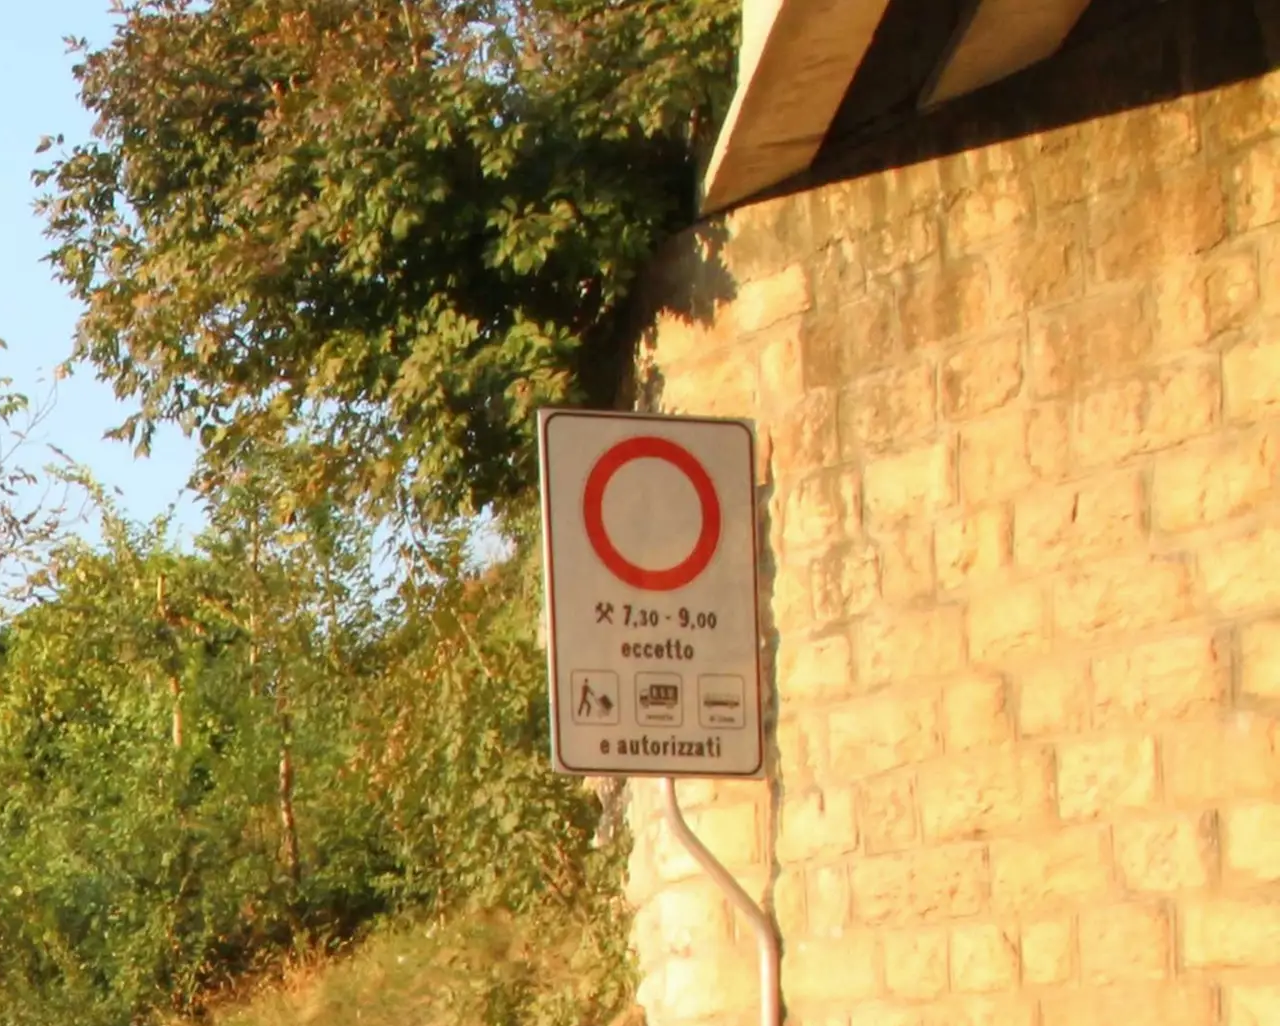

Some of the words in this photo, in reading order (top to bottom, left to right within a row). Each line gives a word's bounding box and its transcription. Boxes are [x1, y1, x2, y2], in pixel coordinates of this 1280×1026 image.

[621, 639, 694, 660] eccetto
[599, 738, 610, 754] e
[617, 735, 721, 757] autorizzati
